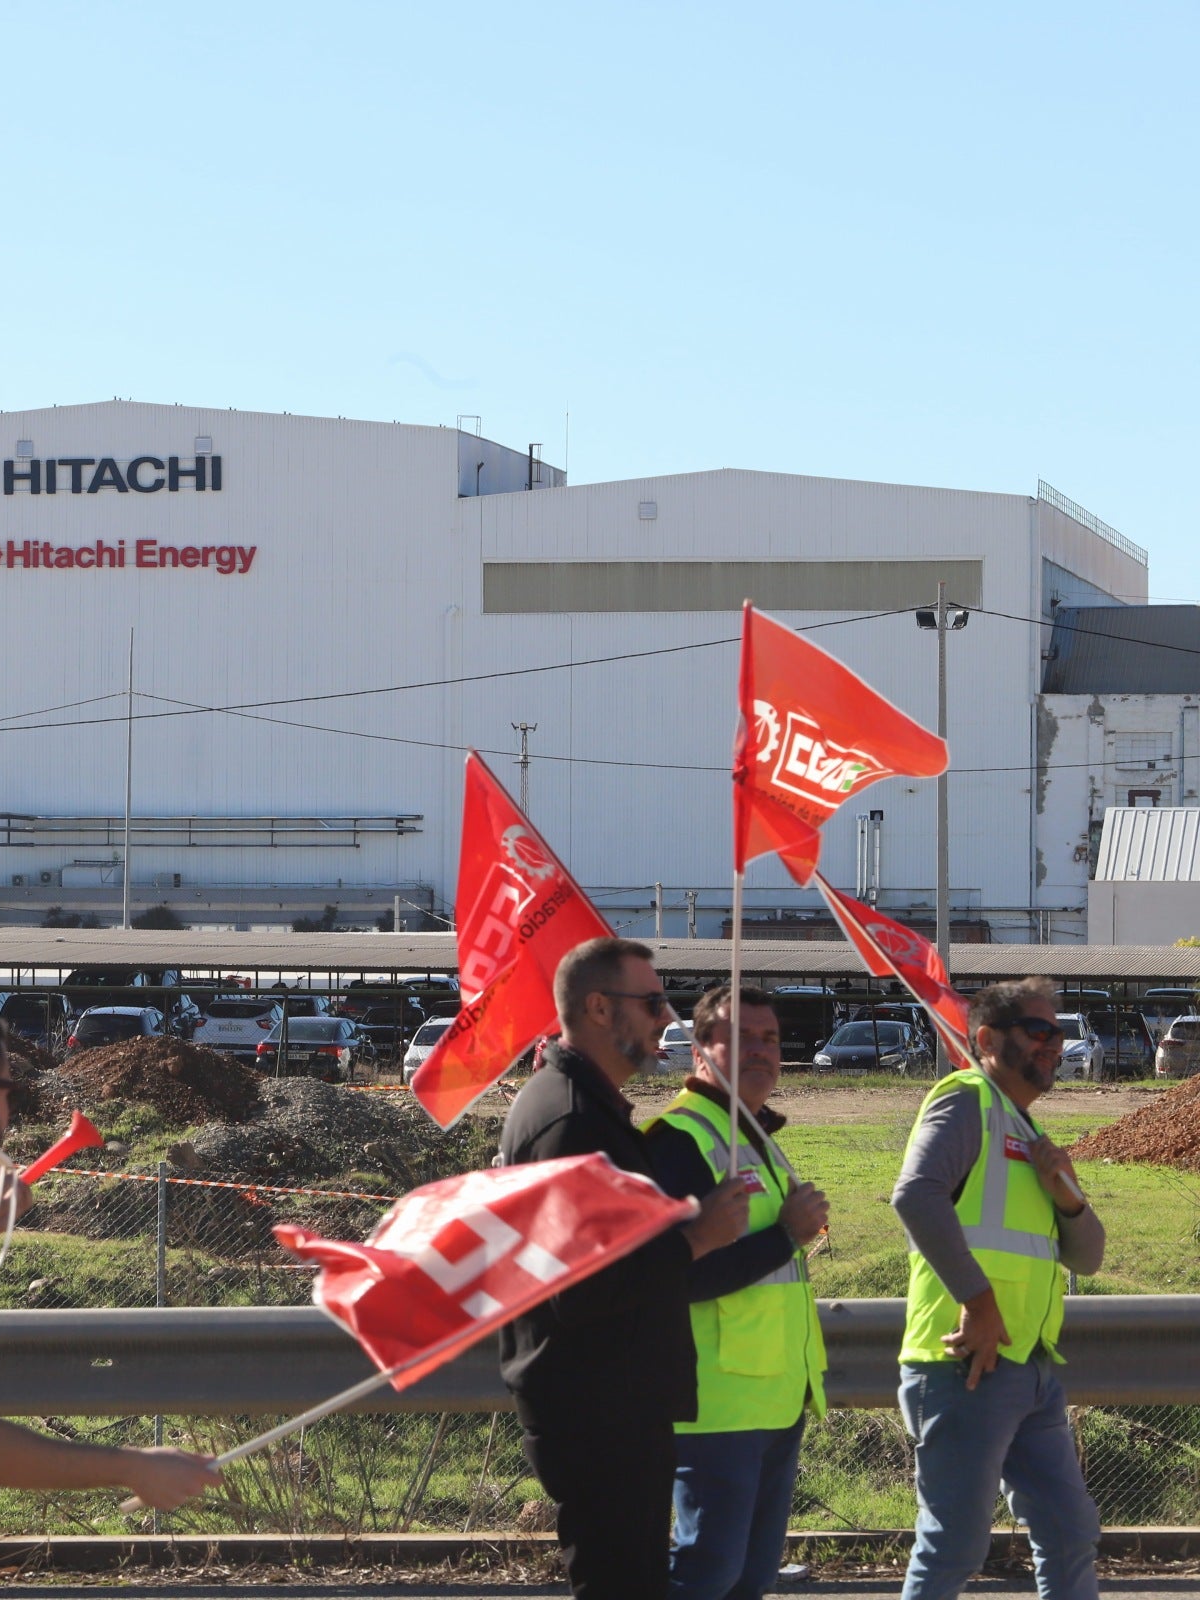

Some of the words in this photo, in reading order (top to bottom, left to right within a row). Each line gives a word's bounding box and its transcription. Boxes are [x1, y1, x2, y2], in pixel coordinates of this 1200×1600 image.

[3, 456, 222, 495] HITACHI
[6, 539, 125, 569] Hitachi
[135, 539, 257, 575] Energy
